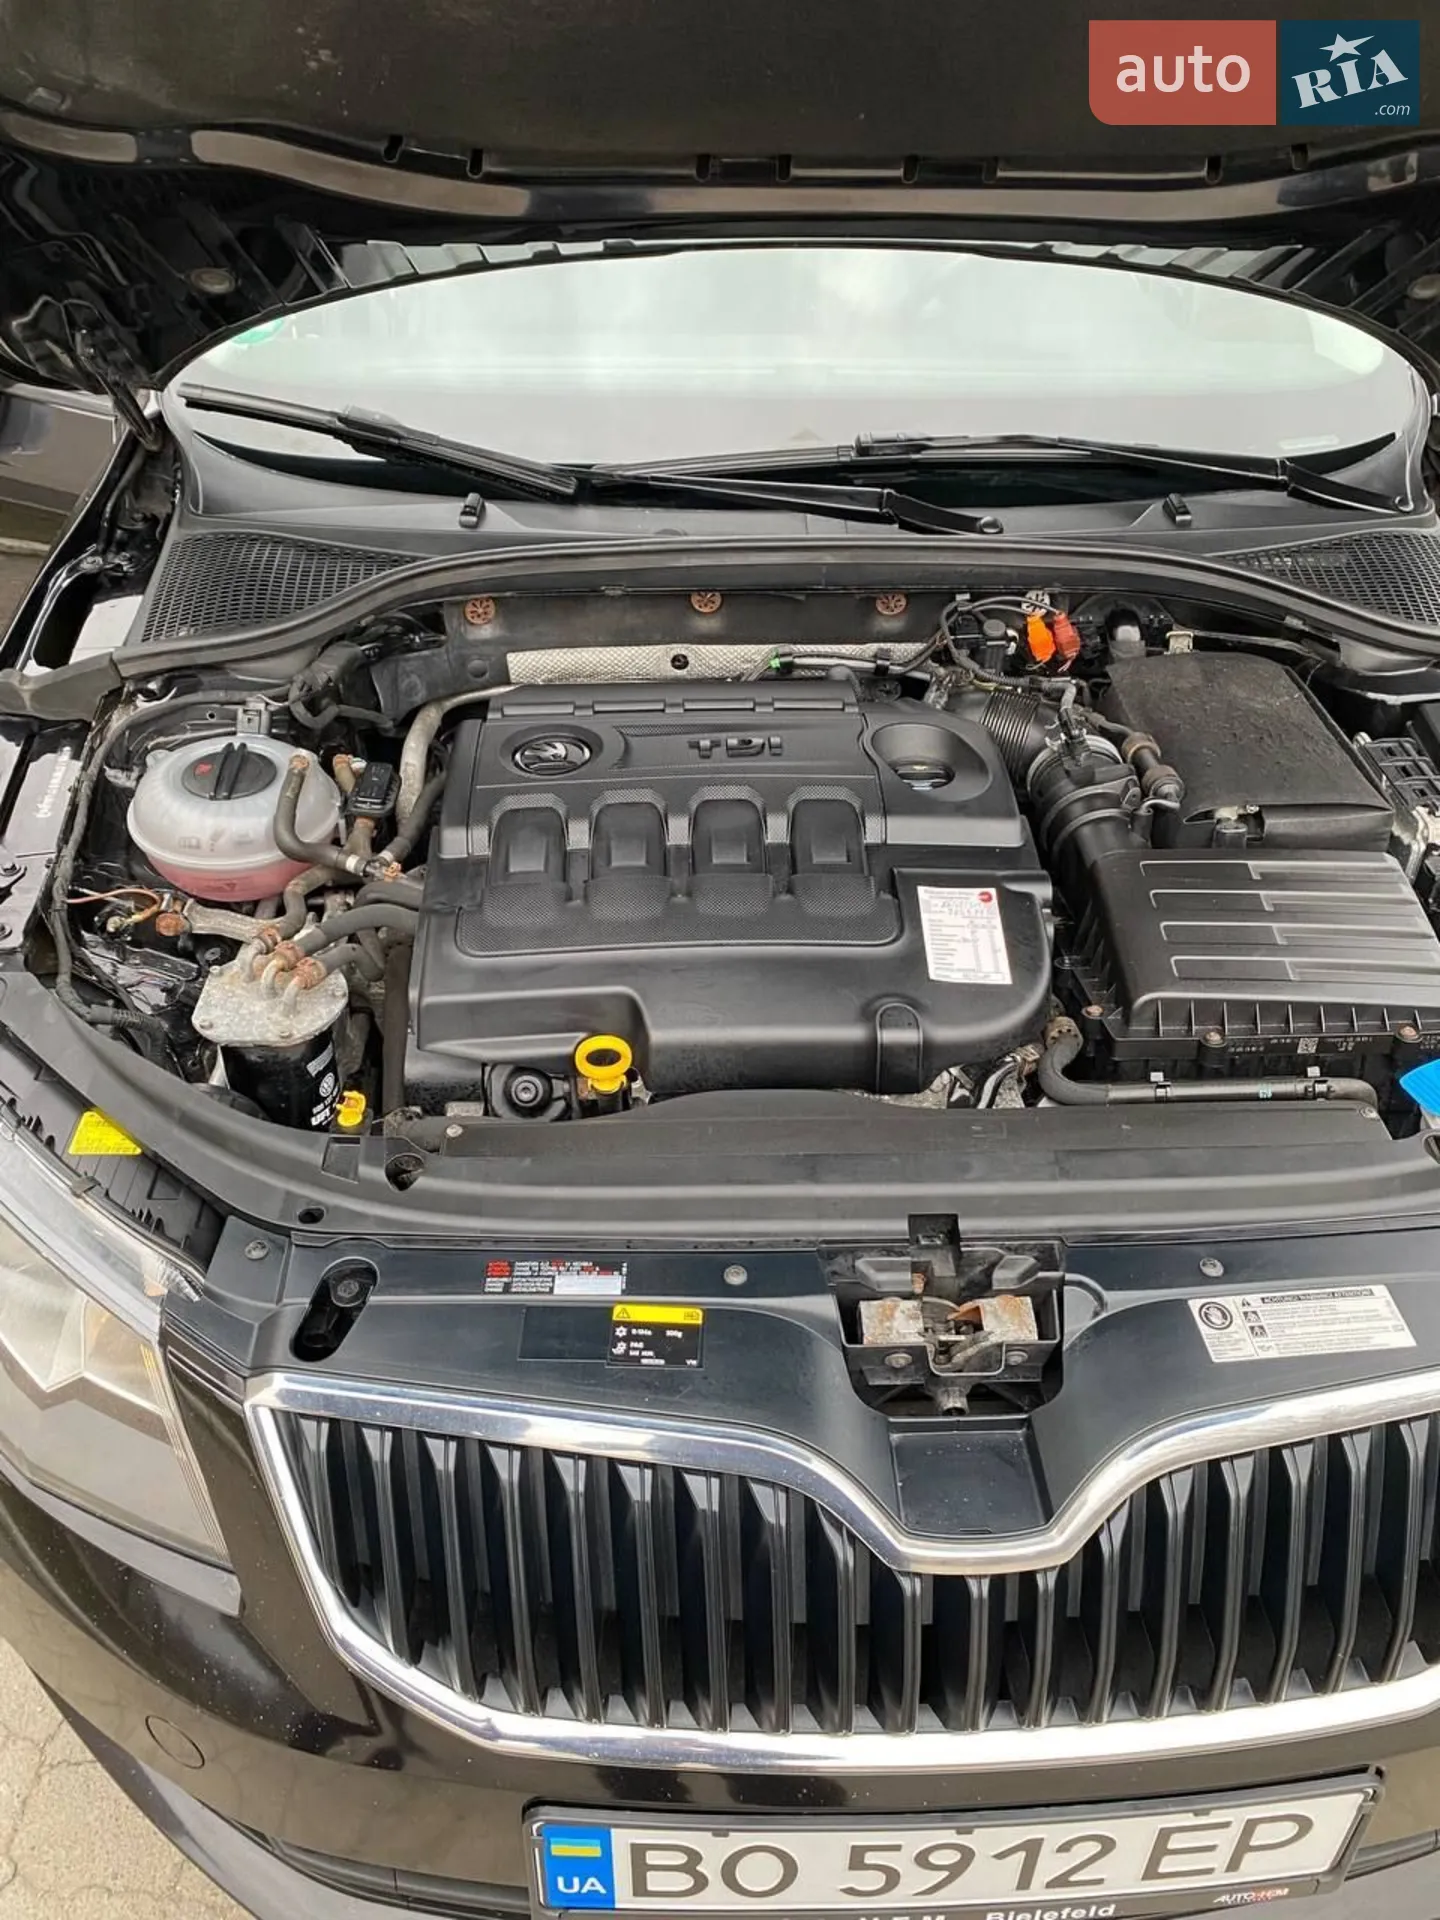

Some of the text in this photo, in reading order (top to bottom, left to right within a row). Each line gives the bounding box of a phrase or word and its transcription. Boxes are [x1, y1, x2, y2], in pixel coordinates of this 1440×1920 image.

[629, 1813, 1315, 1899] BO 5912 EP
[556, 1876, 607, 1894] UA
[985, 1903, 1116, 1920] Bielefeld
